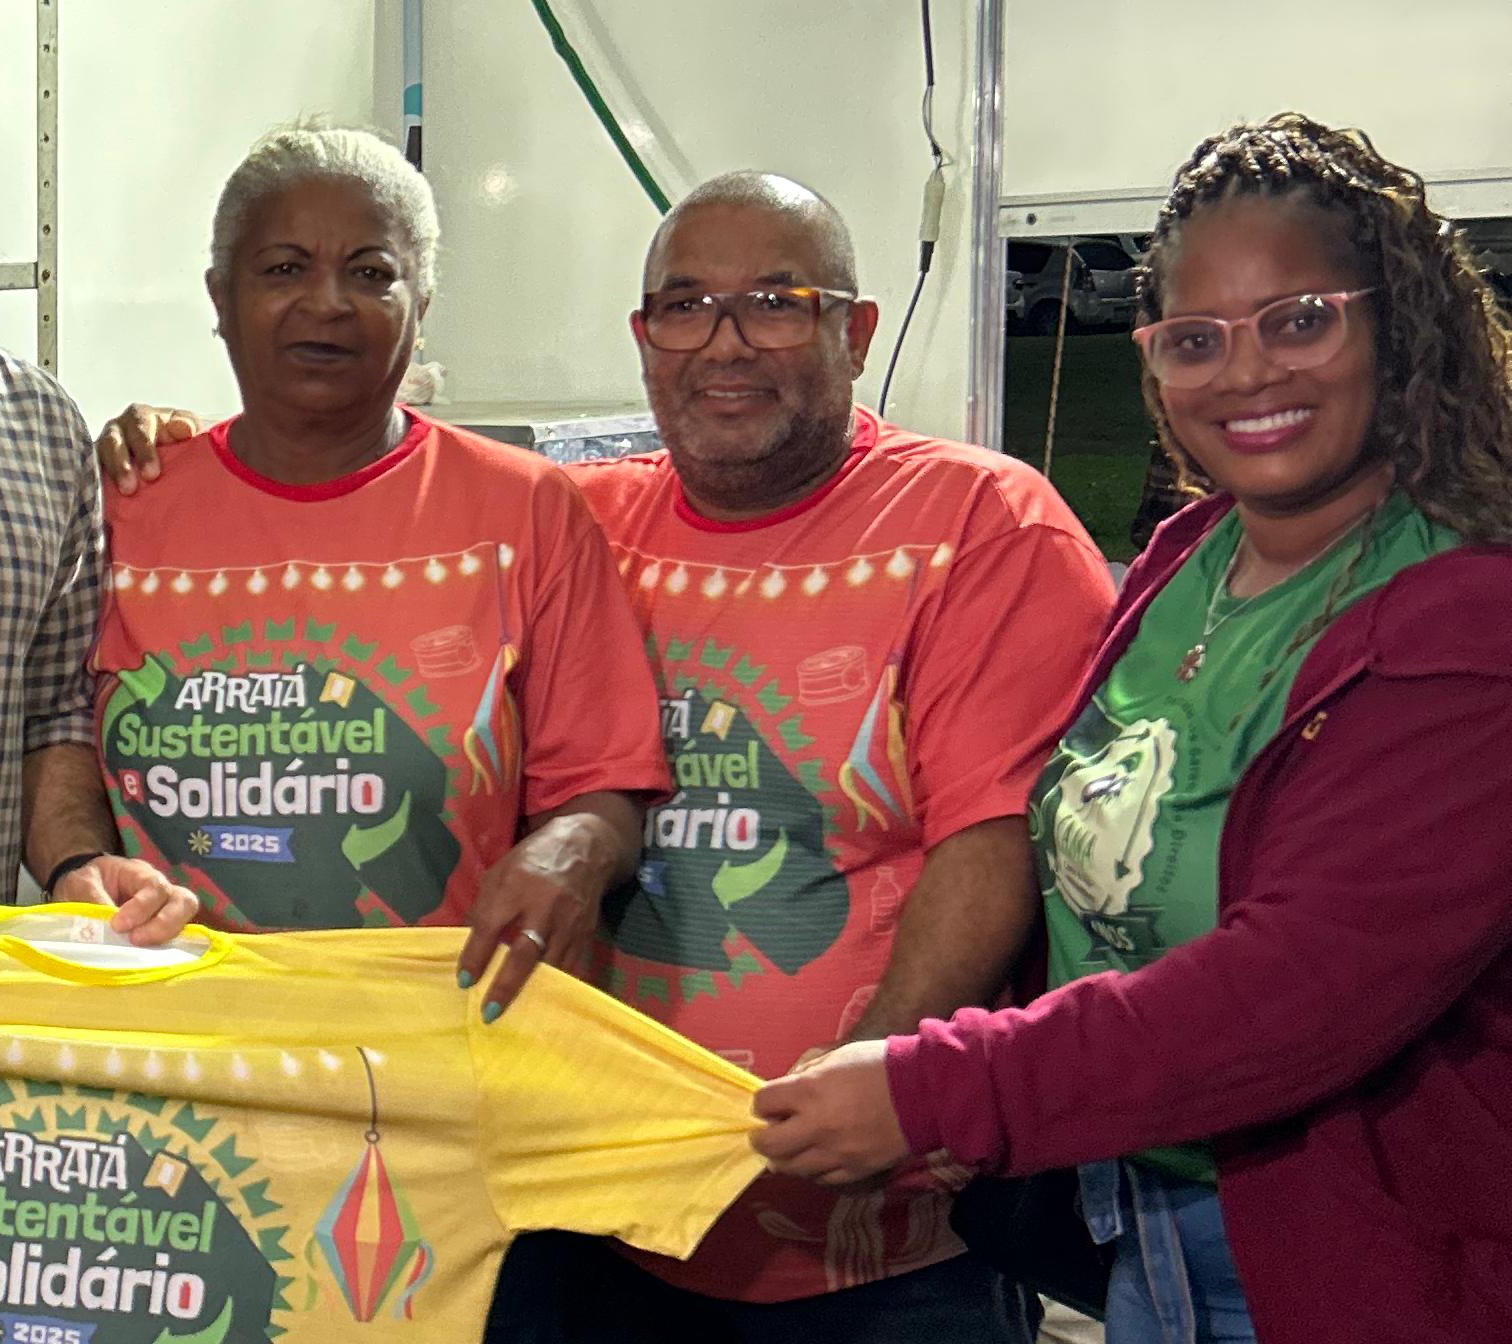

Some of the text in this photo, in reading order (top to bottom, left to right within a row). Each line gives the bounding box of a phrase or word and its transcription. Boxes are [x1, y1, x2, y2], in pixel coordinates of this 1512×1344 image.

[174, 663, 306, 715] ARRAIÁ
[116, 706, 386, 759] Sustentável
[123, 757, 385, 818] e Solidário
[220, 832, 281, 854] 2025
